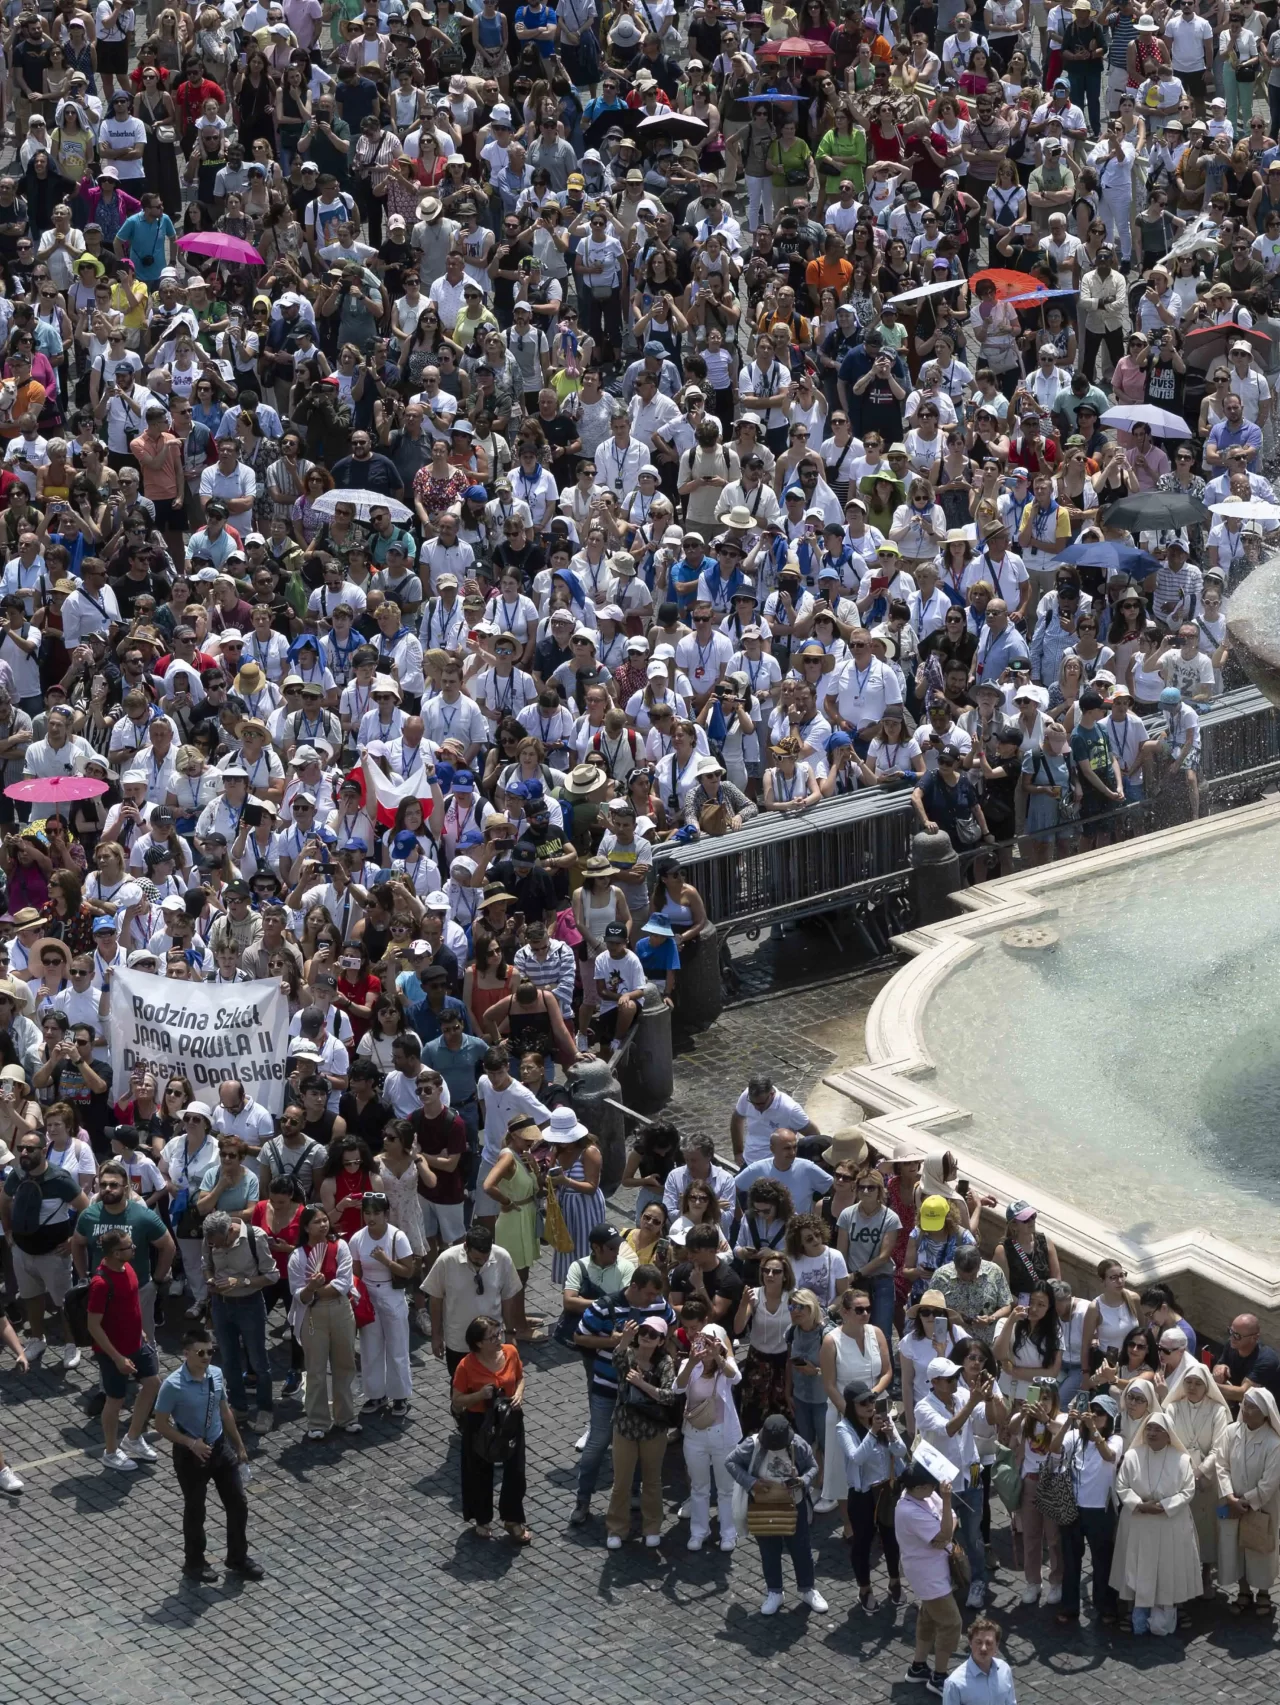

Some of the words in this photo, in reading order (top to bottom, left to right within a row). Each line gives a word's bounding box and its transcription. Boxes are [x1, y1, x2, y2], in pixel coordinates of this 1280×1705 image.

[109, 130, 136, 138] Timberland
[780, 242, 800, 250] LOVE
[132, 995, 209, 1031] Rodzina
[214, 1004, 262, 1031] Szkół
[132, 1023, 172, 1053] JANA
[178, 1033, 252, 1059] PAWŁA
[258, 1031, 274, 1053] II
[193, 1058, 286, 1088] Opolskiej
[92, 1223, 109, 1237] JACK
[850, 1222, 881, 1244] Lee
